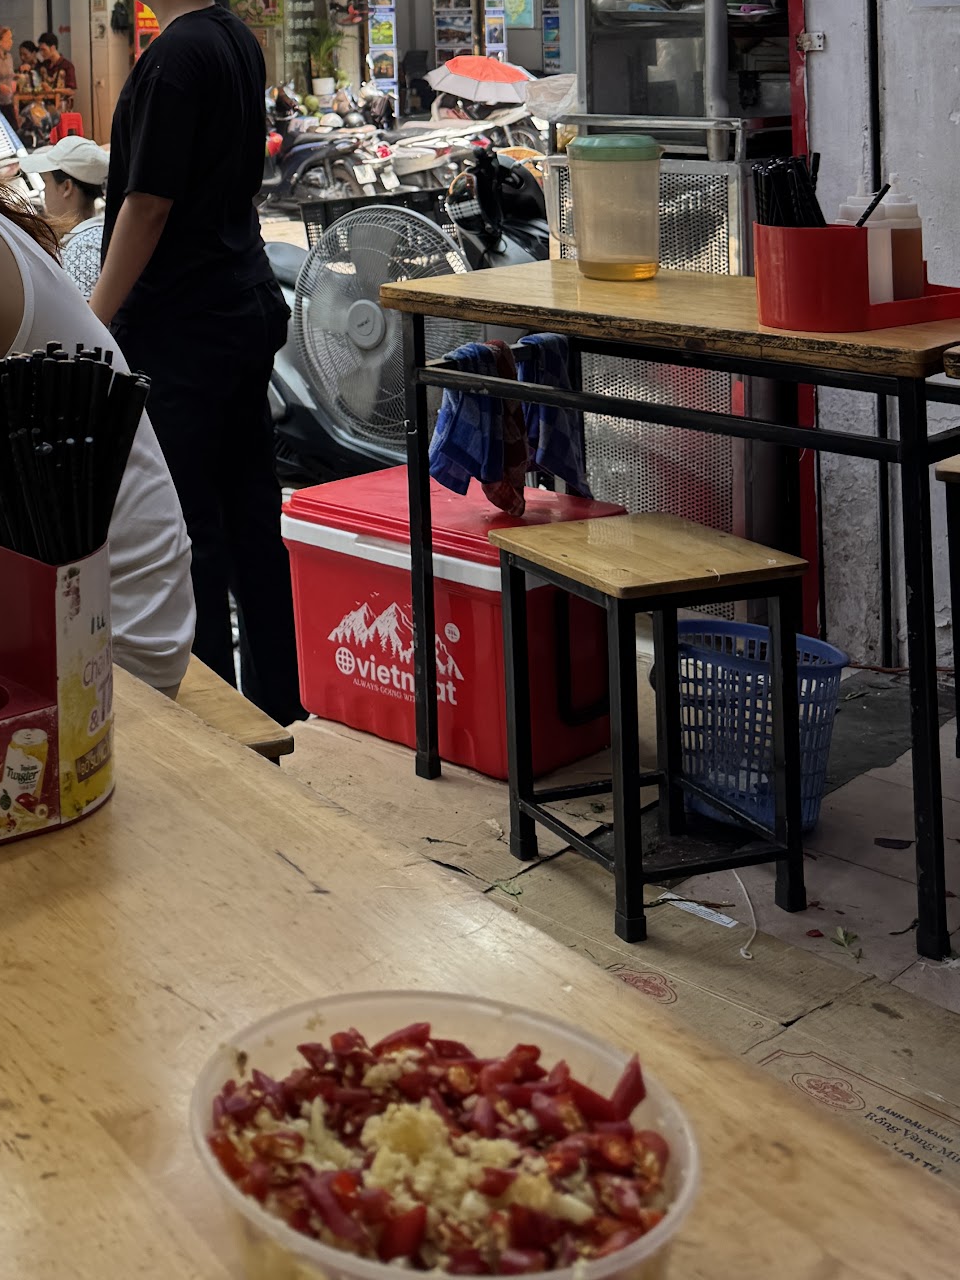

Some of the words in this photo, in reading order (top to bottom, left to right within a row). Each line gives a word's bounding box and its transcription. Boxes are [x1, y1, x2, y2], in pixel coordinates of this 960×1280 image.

[353, 678, 379, 691] ALWAYS
[903, 1128, 938, 1152] Vàng
[925, 1127, 953, 1144] XANH
